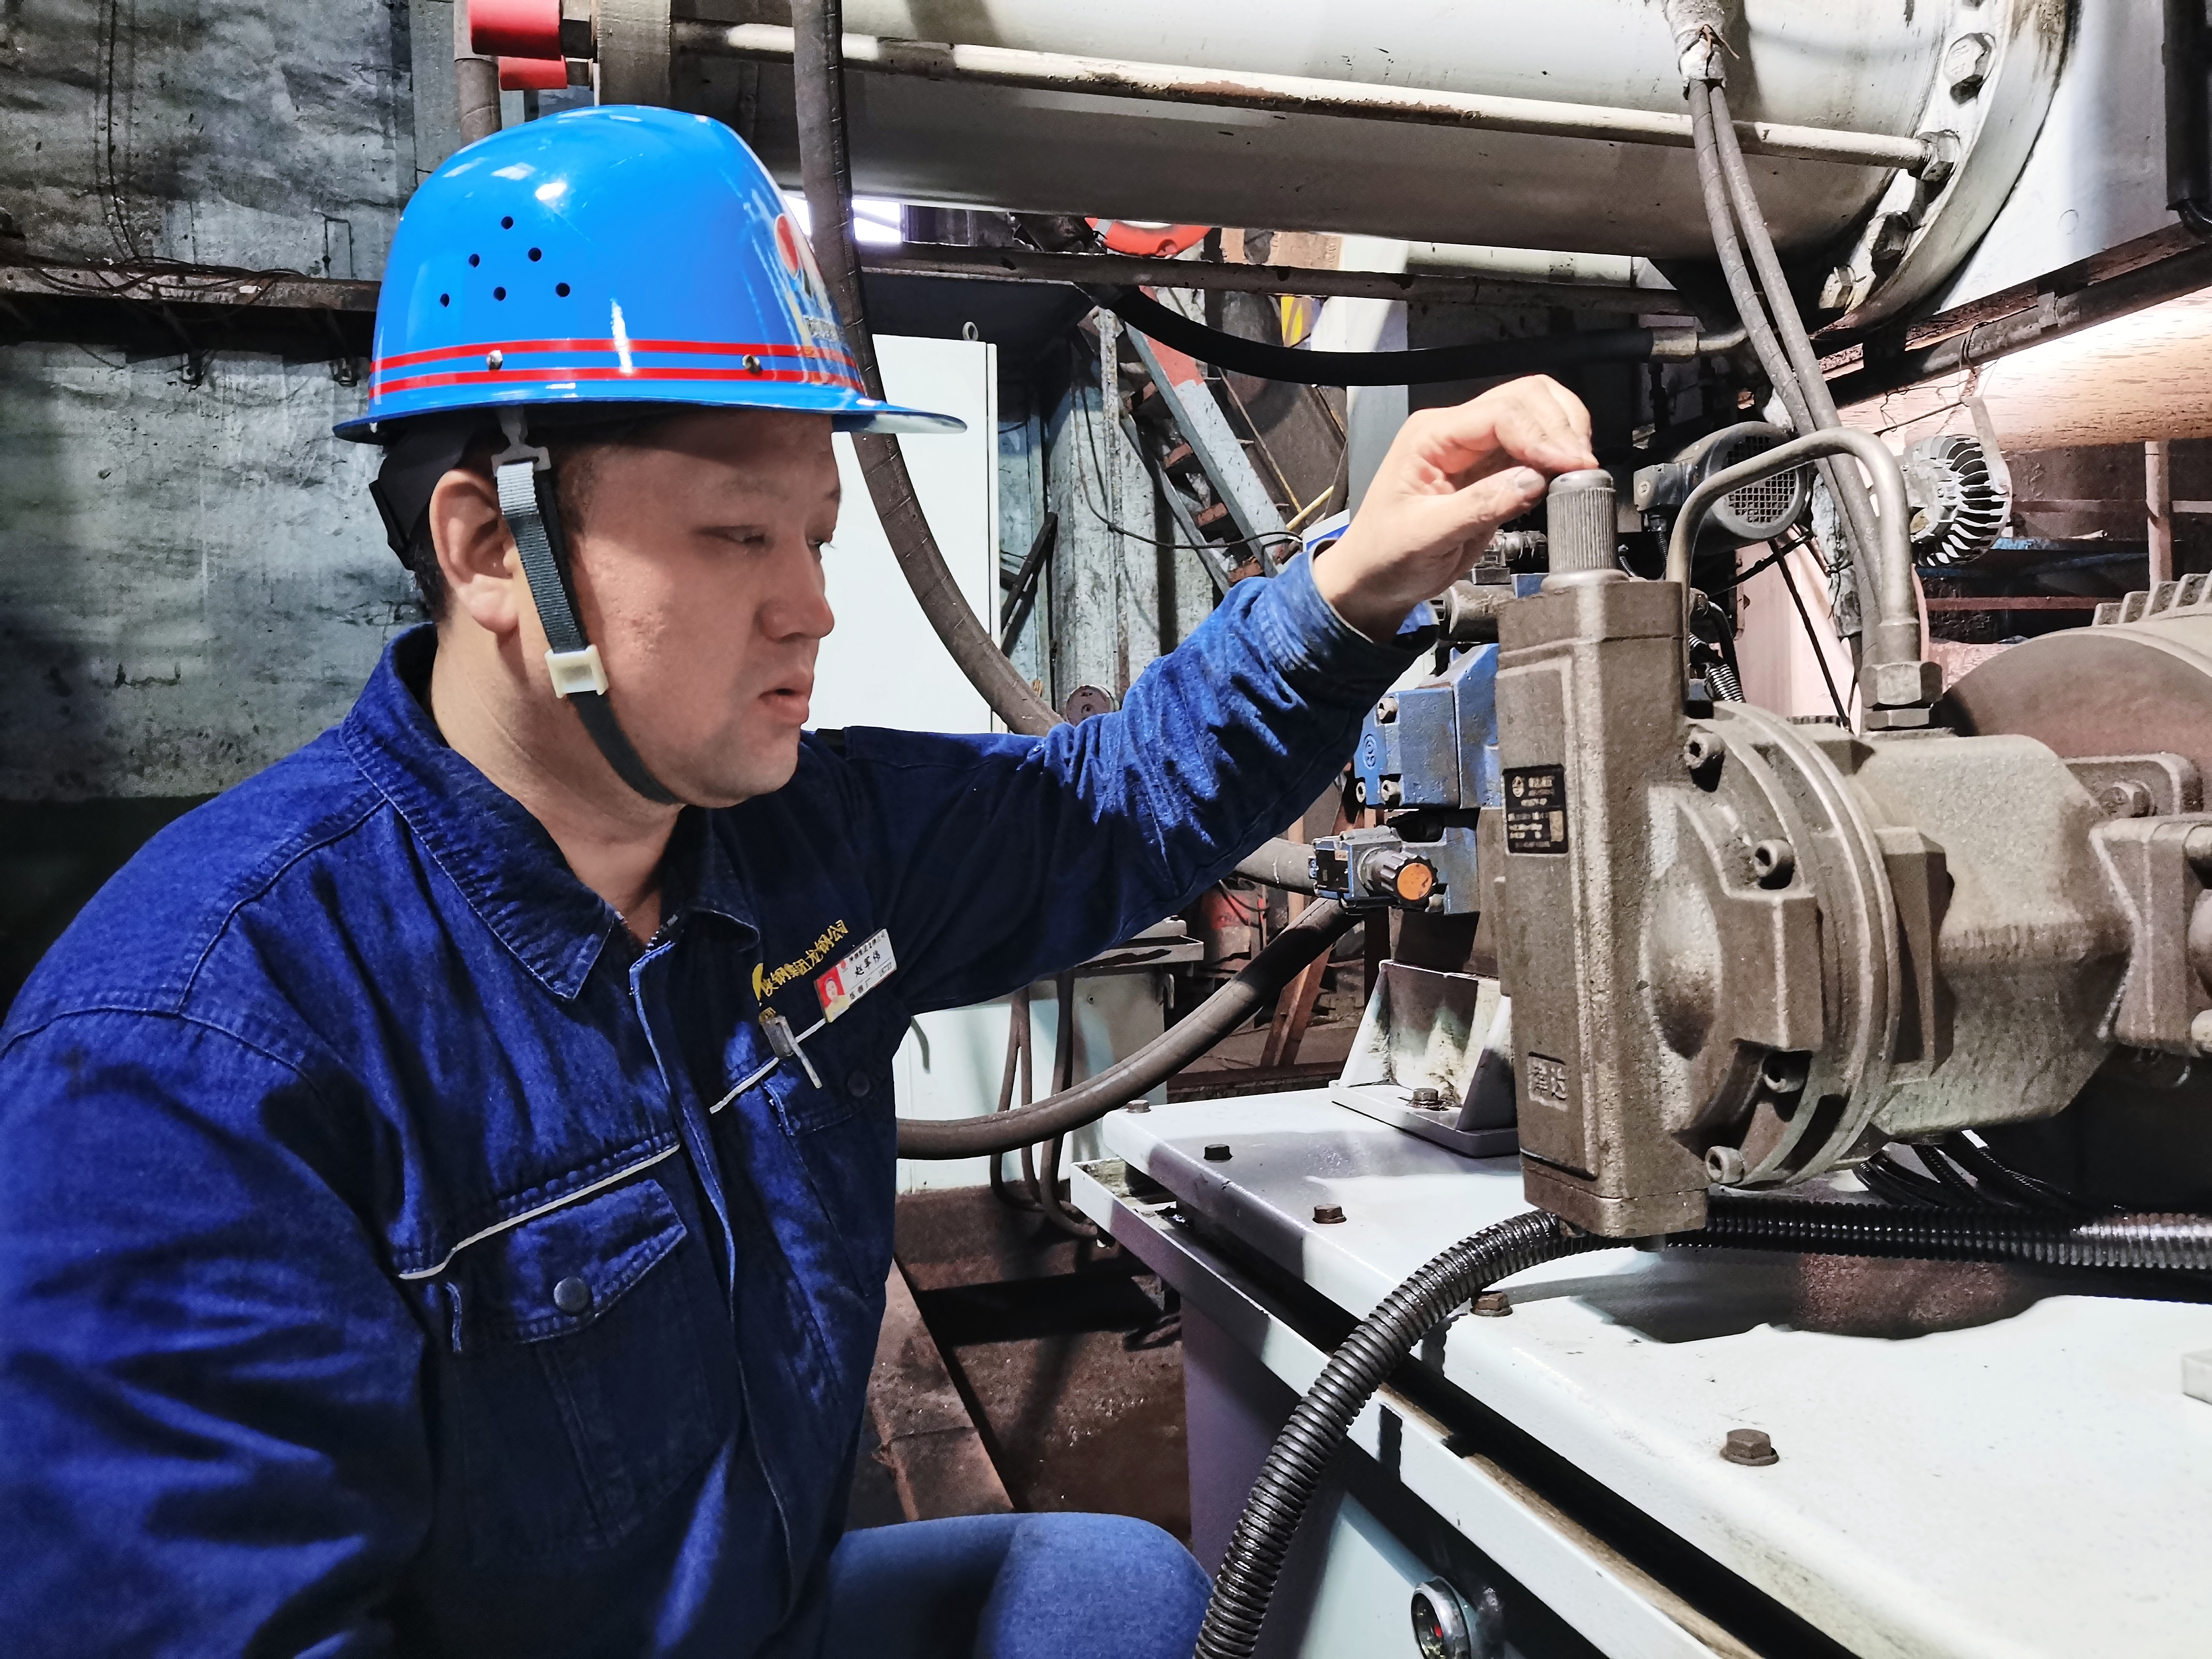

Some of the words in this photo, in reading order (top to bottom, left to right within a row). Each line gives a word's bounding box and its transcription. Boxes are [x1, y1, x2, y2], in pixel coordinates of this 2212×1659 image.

[761, 919, 849, 997] 陕钢集团龙钢公司
